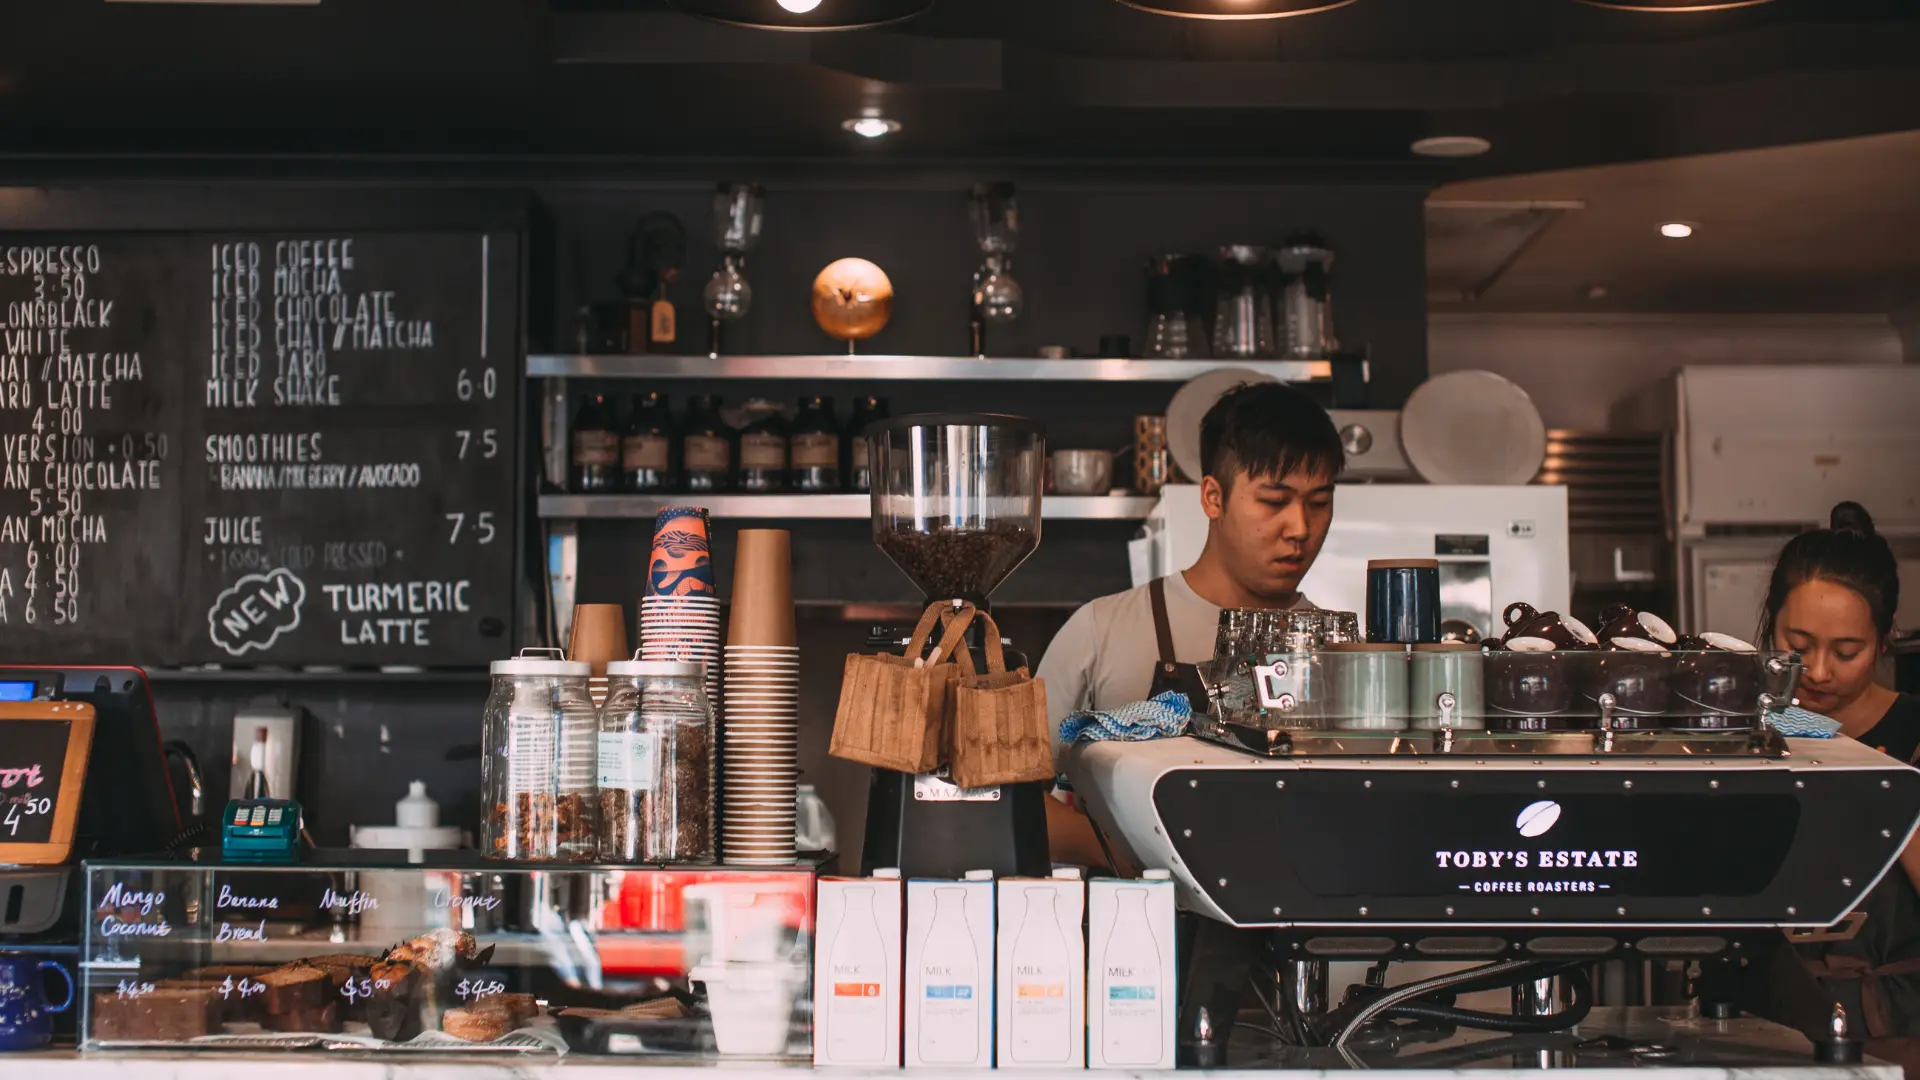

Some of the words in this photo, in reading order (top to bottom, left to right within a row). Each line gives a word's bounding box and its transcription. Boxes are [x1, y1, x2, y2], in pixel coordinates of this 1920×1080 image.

[212, 242, 260, 274] ICED
[275, 238, 353, 270] COFFEE
[212, 270, 260, 298] ICED
[274, 267, 342, 296] MOCHA
[212, 298, 261, 326] ICED
[274, 290, 395, 326] CHOCOLATE
[5, 328, 71, 356] WHITE
[212, 323, 261, 354] ICED
[211, 351, 260, 380] ICED
[276, 349, 326, 379] TARO
[48, 380, 112, 409] LATTE
[206, 378, 259, 407] MILK
[273, 374, 341, 406] SHAKE
[4, 433, 95, 463] VERSION
[205, 432, 323, 463] SMOOTHIES
[4, 462, 30, 490] AN
[45, 460, 161, 491] CHOCOLATE
[1, 515, 29, 543] AN
[41, 514, 107, 543] MOCHA
[204, 516, 263, 545] JUICE
[222, 574, 290, 639] NEW
[322, 580, 471, 613] TURMERIC
[340, 618, 430, 646] LATTE
[1436, 851, 1529, 868] TOBY'S
[1539, 851, 1638, 868] ESTATE
[101, 882, 165, 916] Mango
[217, 884, 279, 909] Banana
[319, 887, 379, 915] Muffin
[1474, 881, 1522, 892] COFFEE
[1527, 881, 1595, 892] ROASTERS
[101, 914, 172, 938] Coconut
[216, 919, 268, 944] Bread
[834, 964, 861, 975] MILK
[925, 966, 952, 976] MILK
[1017, 965, 1043, 976] MILK
[1108, 967, 1135, 978] MILK
